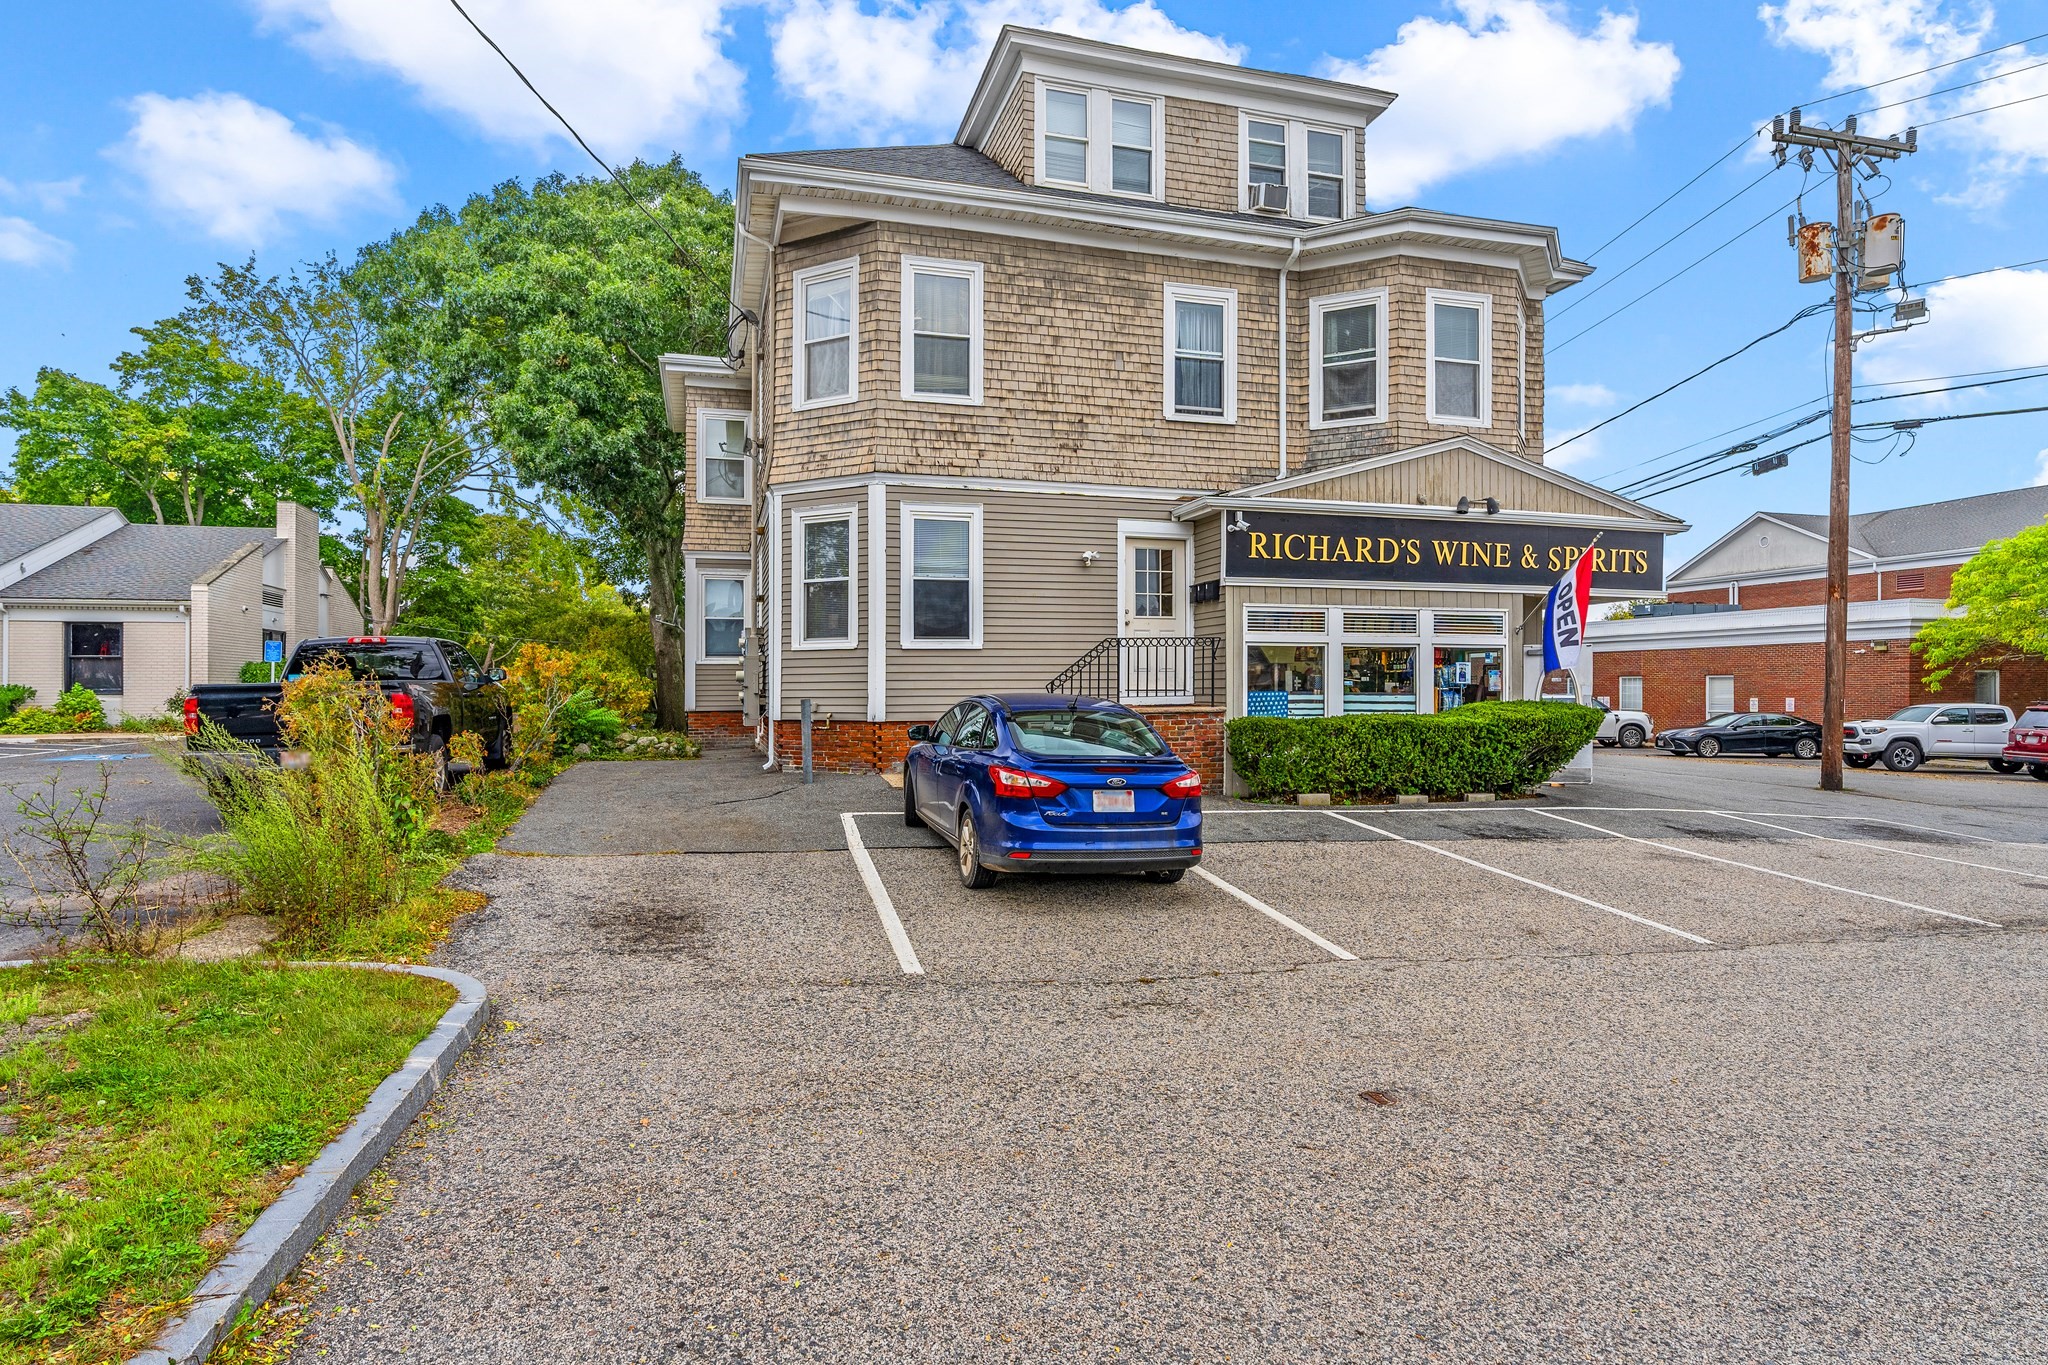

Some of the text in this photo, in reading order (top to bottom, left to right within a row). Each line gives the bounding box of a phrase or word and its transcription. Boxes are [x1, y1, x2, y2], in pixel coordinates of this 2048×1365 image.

[1248, 532, 1648, 574] RICHARD'S WINE & SPRITS
[1557, 581, 1579, 648] OPEN
